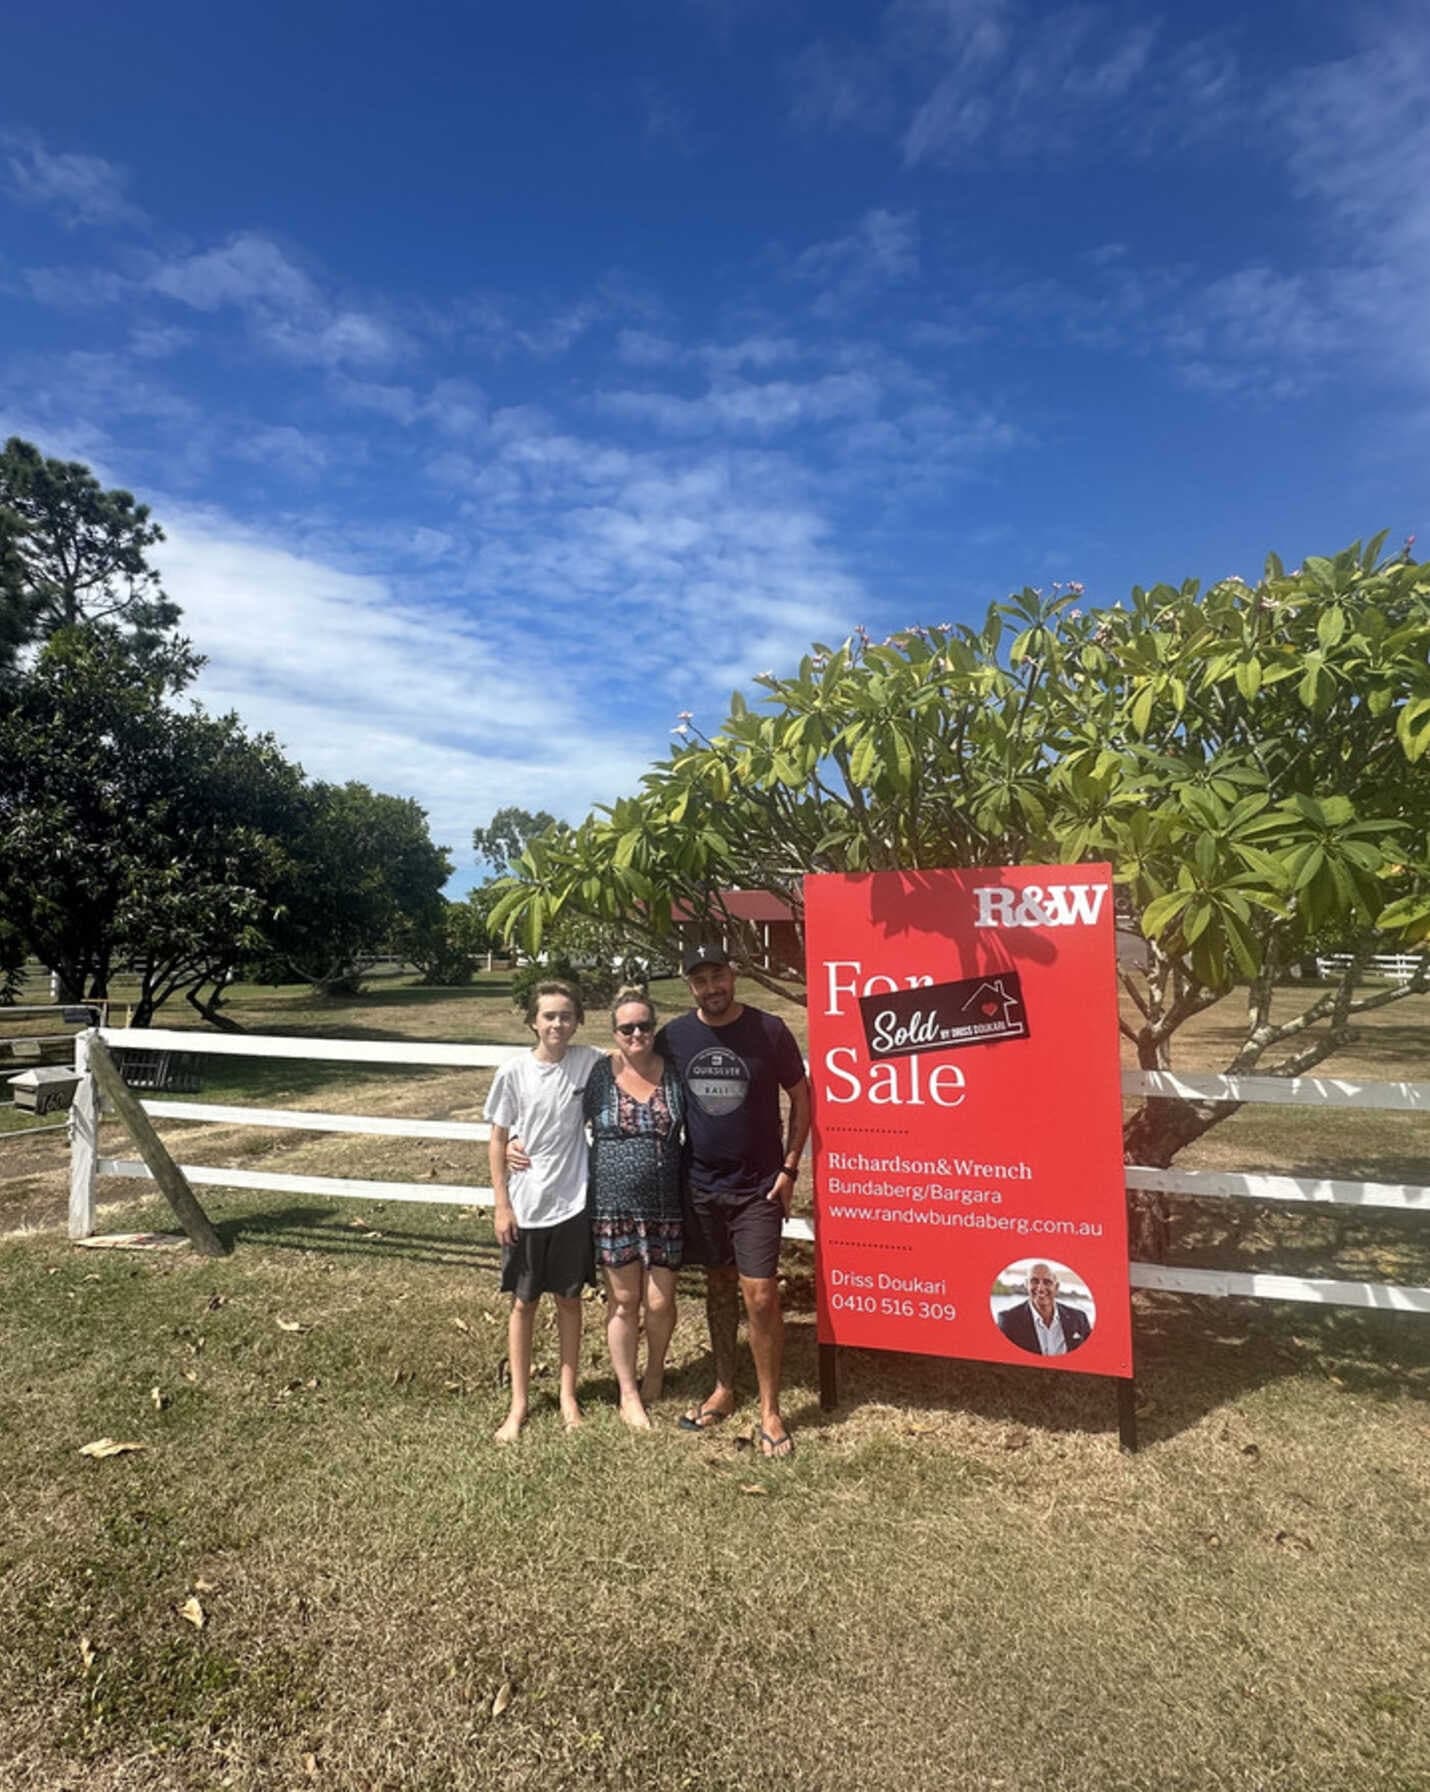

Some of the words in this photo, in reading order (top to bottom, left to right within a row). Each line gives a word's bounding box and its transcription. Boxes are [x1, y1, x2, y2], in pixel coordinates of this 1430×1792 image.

[973, 884, 1108, 928] R&W
[872, 1010, 939, 1052] Sold
[825, 1046, 966, 1107] Sale
[828, 1178, 1002, 1204] Bundaberg/Bargara
[828, 1204, 1104, 1236] www.randwbundaberg.com.au
[832, 1269, 874, 1288] Driss
[878, 1273, 946, 1295] Doukari
[832, 1293, 877, 1313] 0410
[881, 1298, 914, 1317] 516
[918, 1302, 956, 1321] 309
